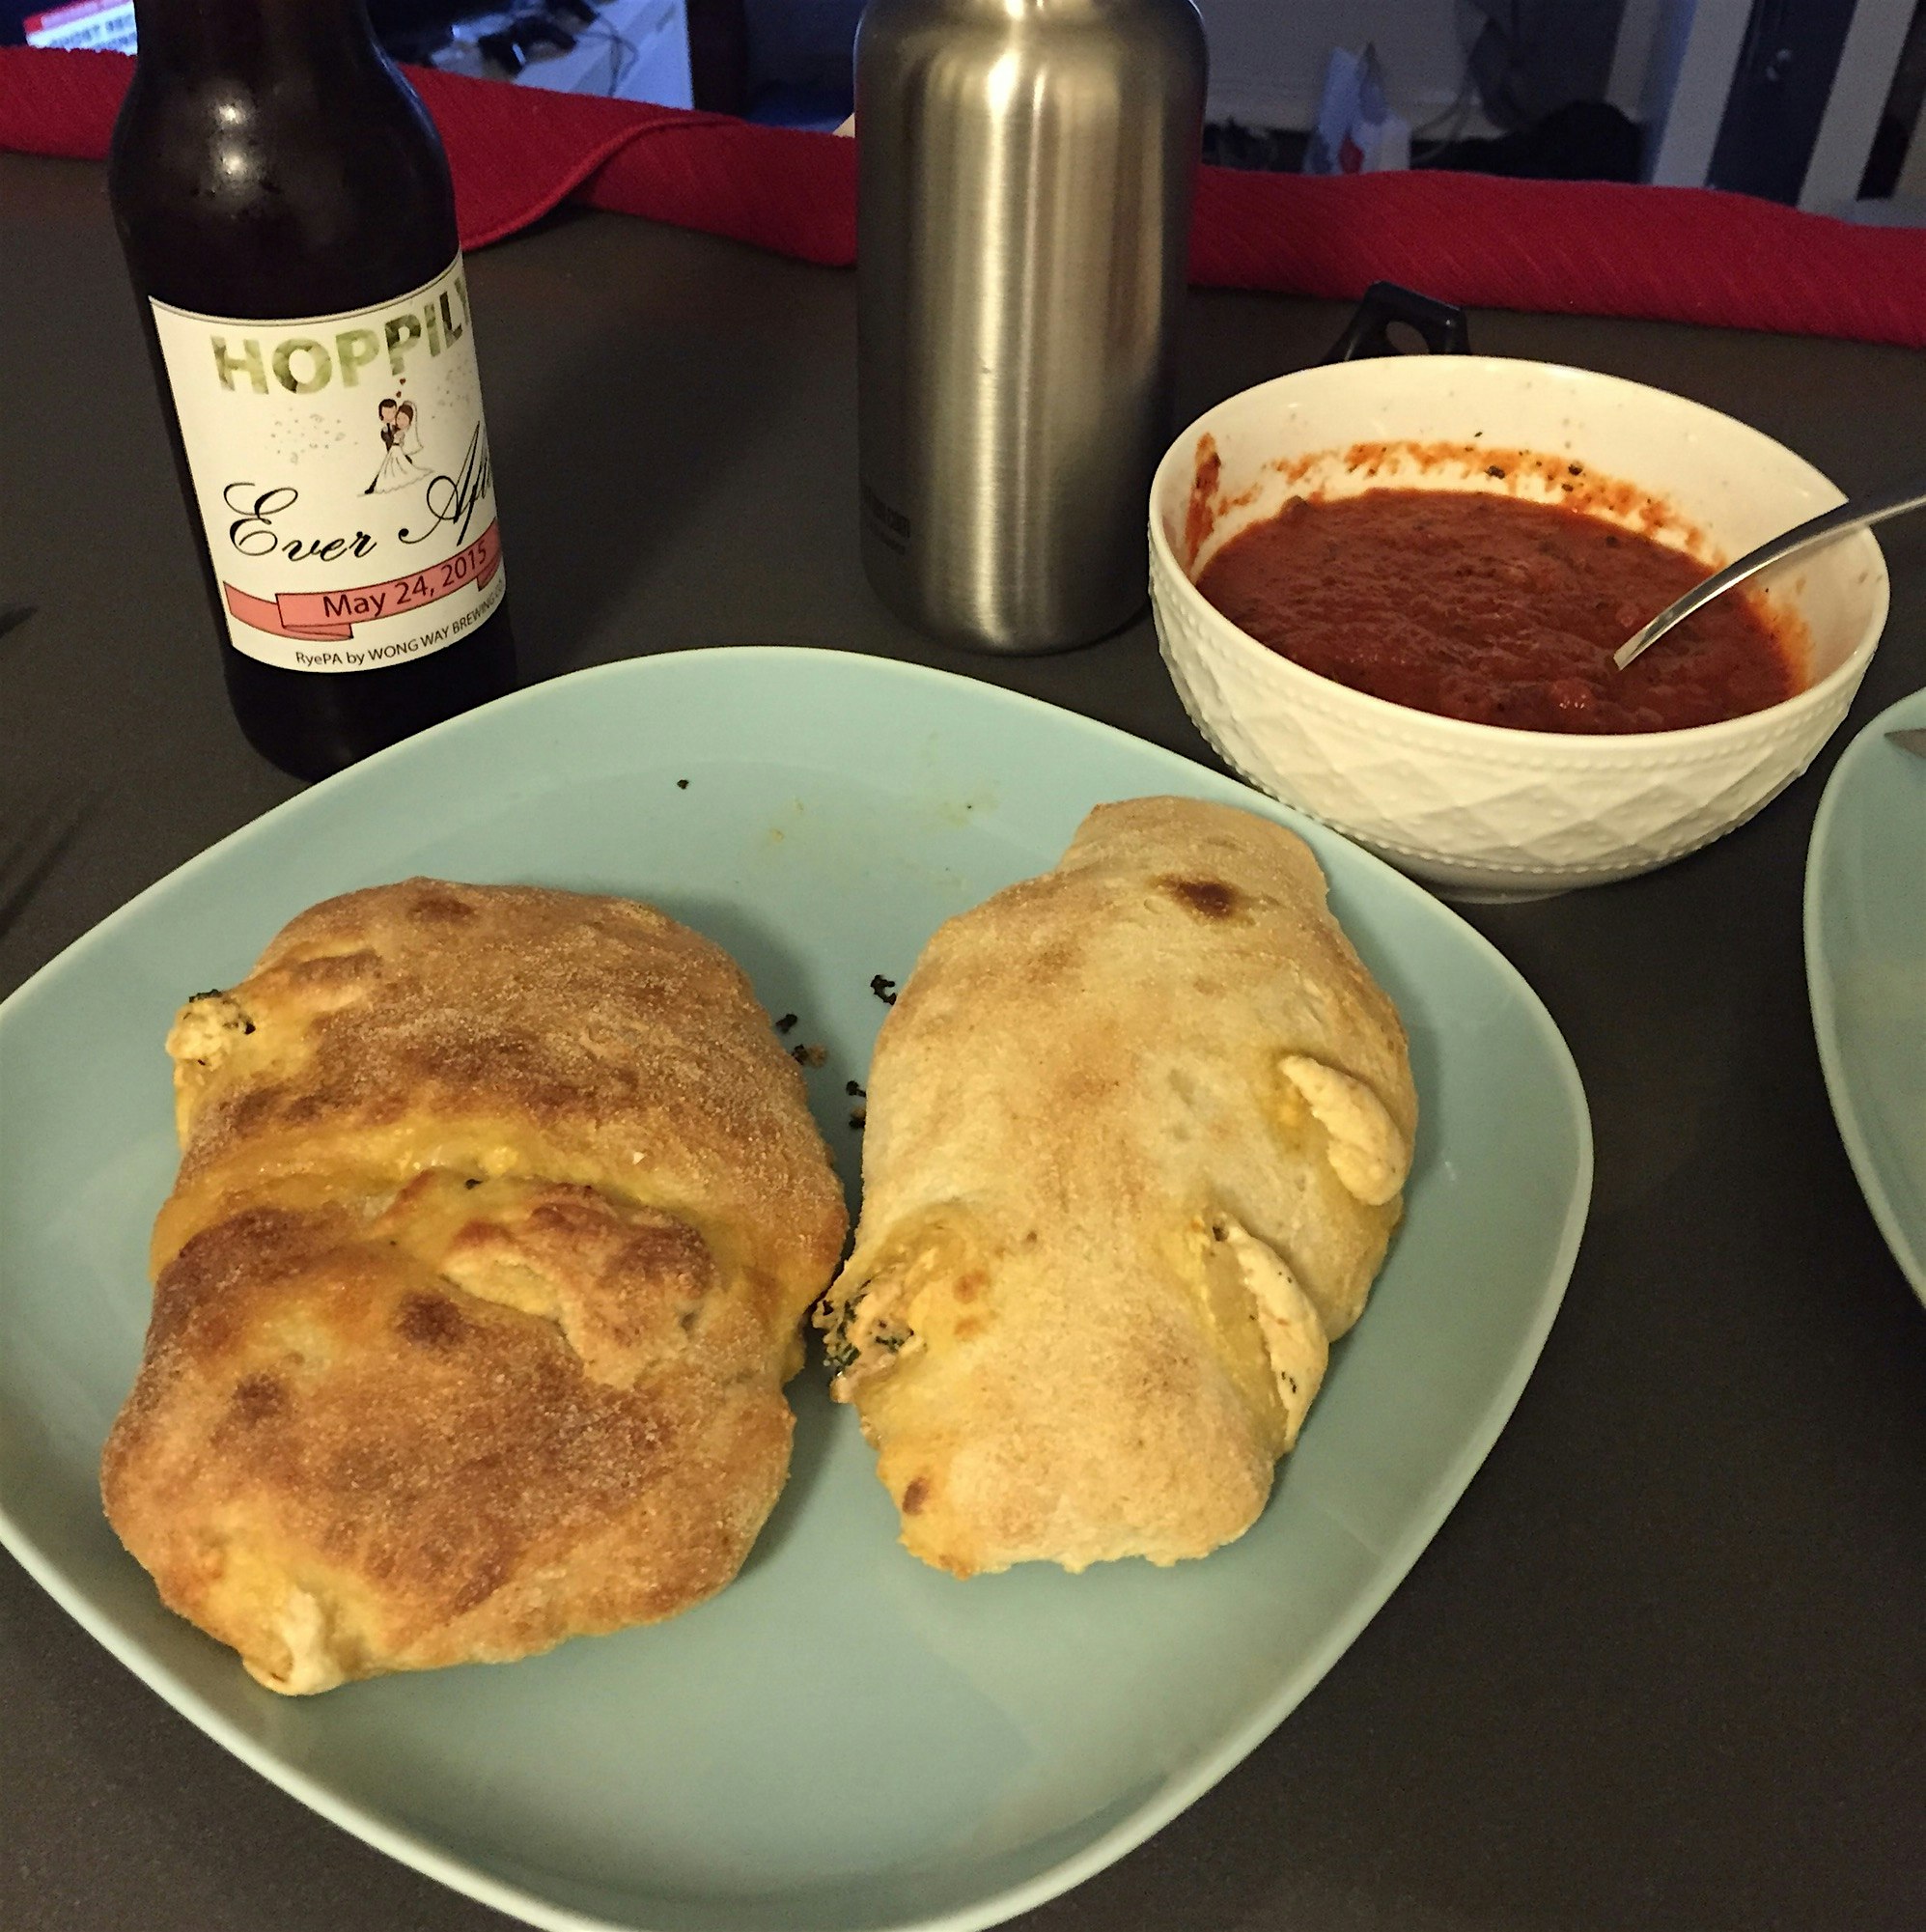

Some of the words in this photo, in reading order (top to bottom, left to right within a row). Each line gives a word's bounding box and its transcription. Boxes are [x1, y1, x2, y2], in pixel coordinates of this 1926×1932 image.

[222, 482, 377, 563] Ever
[323, 592, 386, 618] May
[395, 576, 434, 605] 24,
[441, 540, 487, 588] 2015
[295, 651, 344, 667] RyePA
[347, 651, 365, 666] by
[368, 639, 419, 661] WONG
[420, 627, 451, 649] WAY
[452, 592, 495, 634] BREWING
